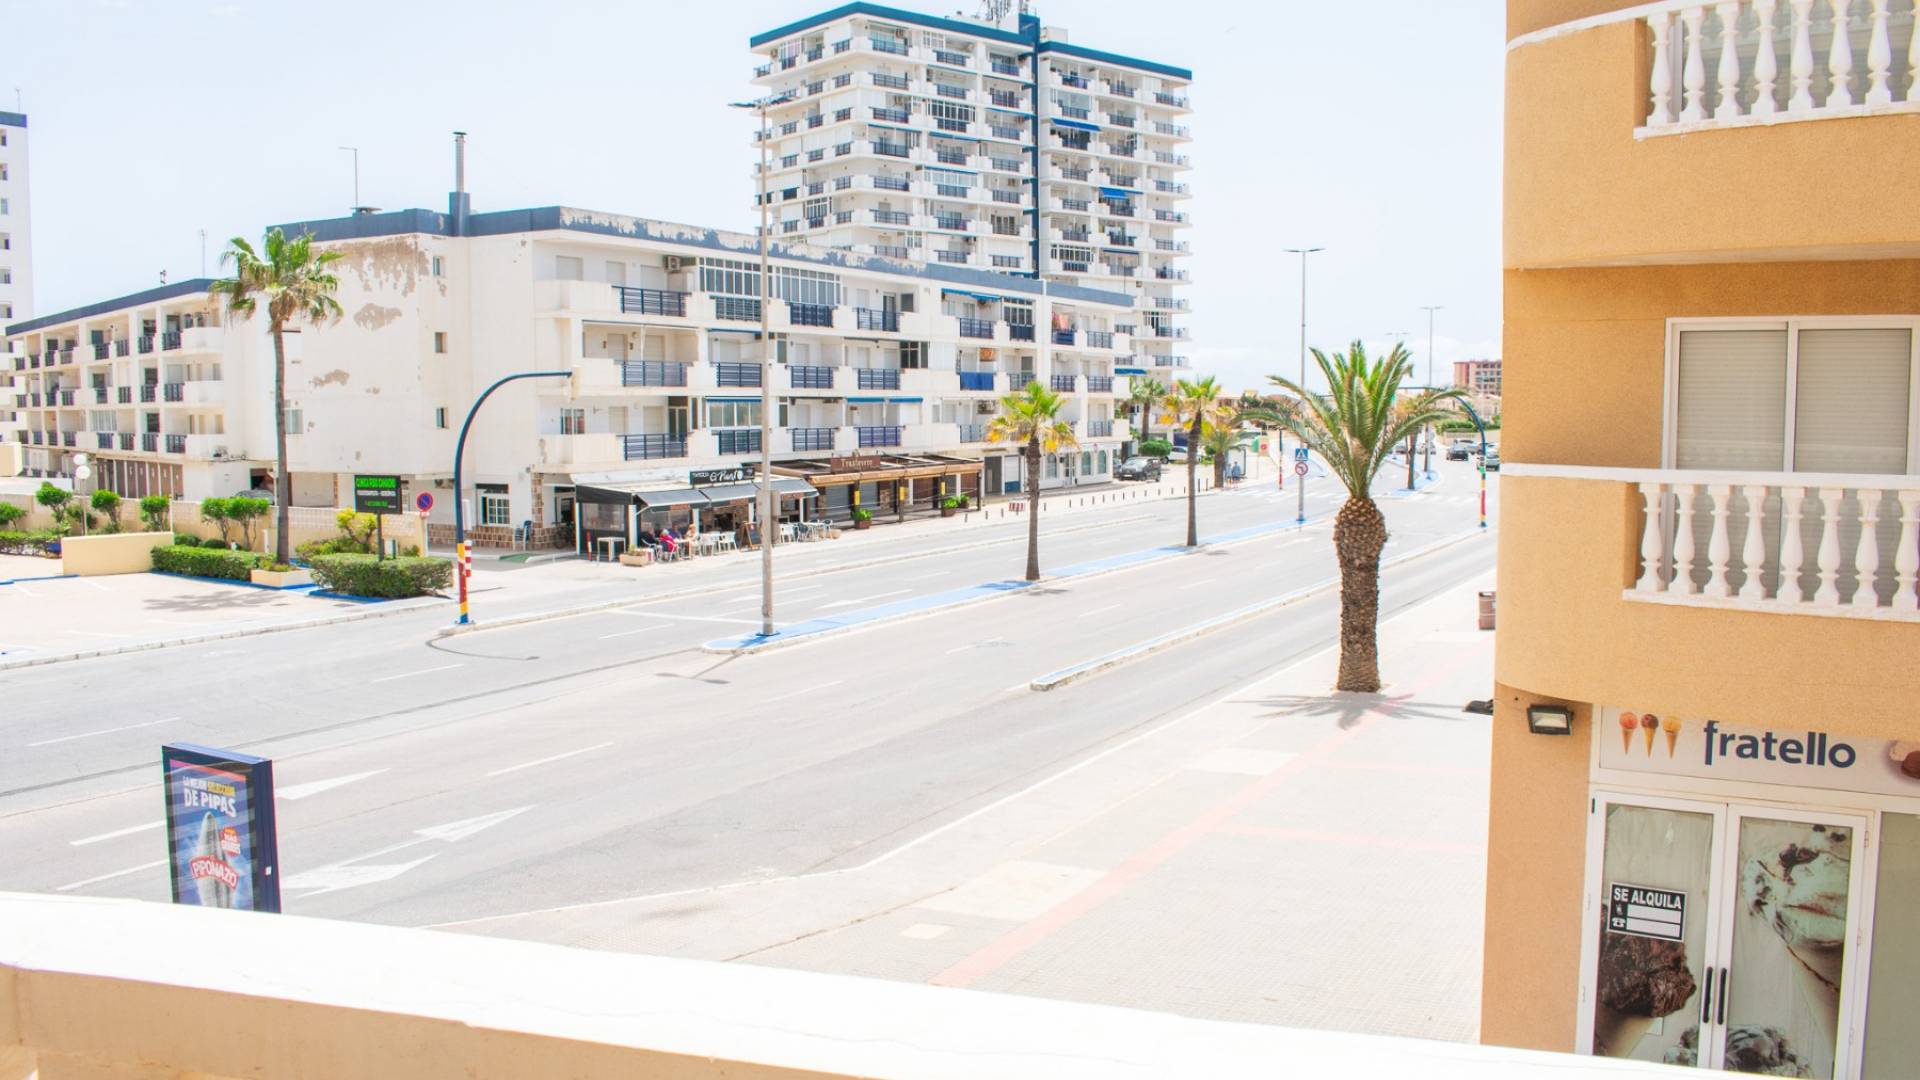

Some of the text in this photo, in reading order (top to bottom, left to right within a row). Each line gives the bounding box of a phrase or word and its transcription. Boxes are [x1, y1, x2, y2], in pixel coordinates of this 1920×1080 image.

[1704, 720, 1856, 768] fratello
[184, 788, 237, 818] DE PIPAS
[192, 860, 237, 887] PIPONAZO
[1613, 887, 1682, 910] SE ALQUILA
